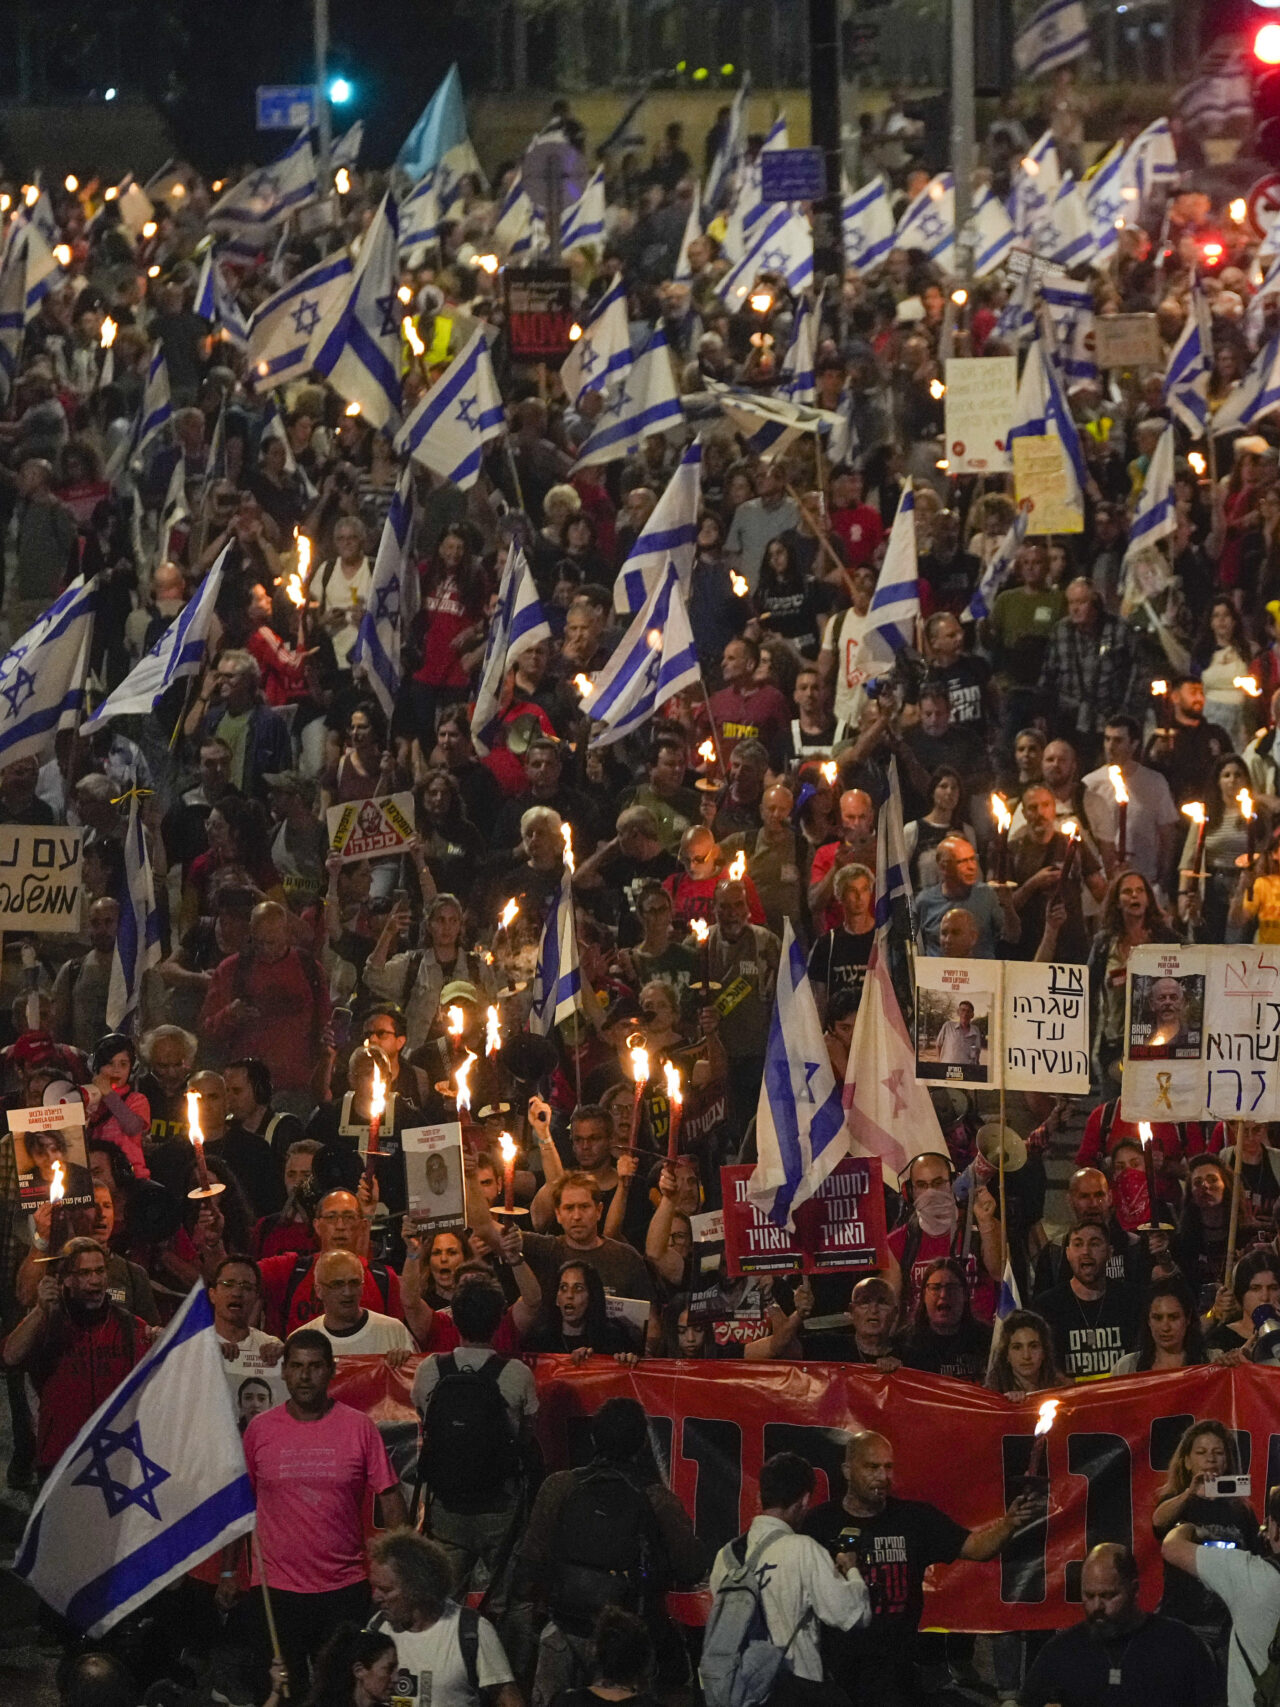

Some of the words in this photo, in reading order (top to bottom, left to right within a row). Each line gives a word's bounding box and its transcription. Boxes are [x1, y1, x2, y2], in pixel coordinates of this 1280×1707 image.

[32, 838, 80, 871] עם
[1048, 965, 1083, 993] אין
[1013, 996, 1080, 1018] שגרה!
[1026, 1019, 1065, 1041] עד
[1131, 1035, 1144, 1045] HIM
[1132, 1024, 1152, 1034] BRING
[1206, 1033, 1280, 1061] שהוא
[1008, 1047, 1088, 1075] העסקה!
[824, 1198, 858, 1222] נגמר
[820, 1221, 866, 1247] האוויר
[690, 1302, 707, 1312] HIM
[692, 1290, 718, 1301] BRING
[1069, 1326, 1122, 1351] בוחים
